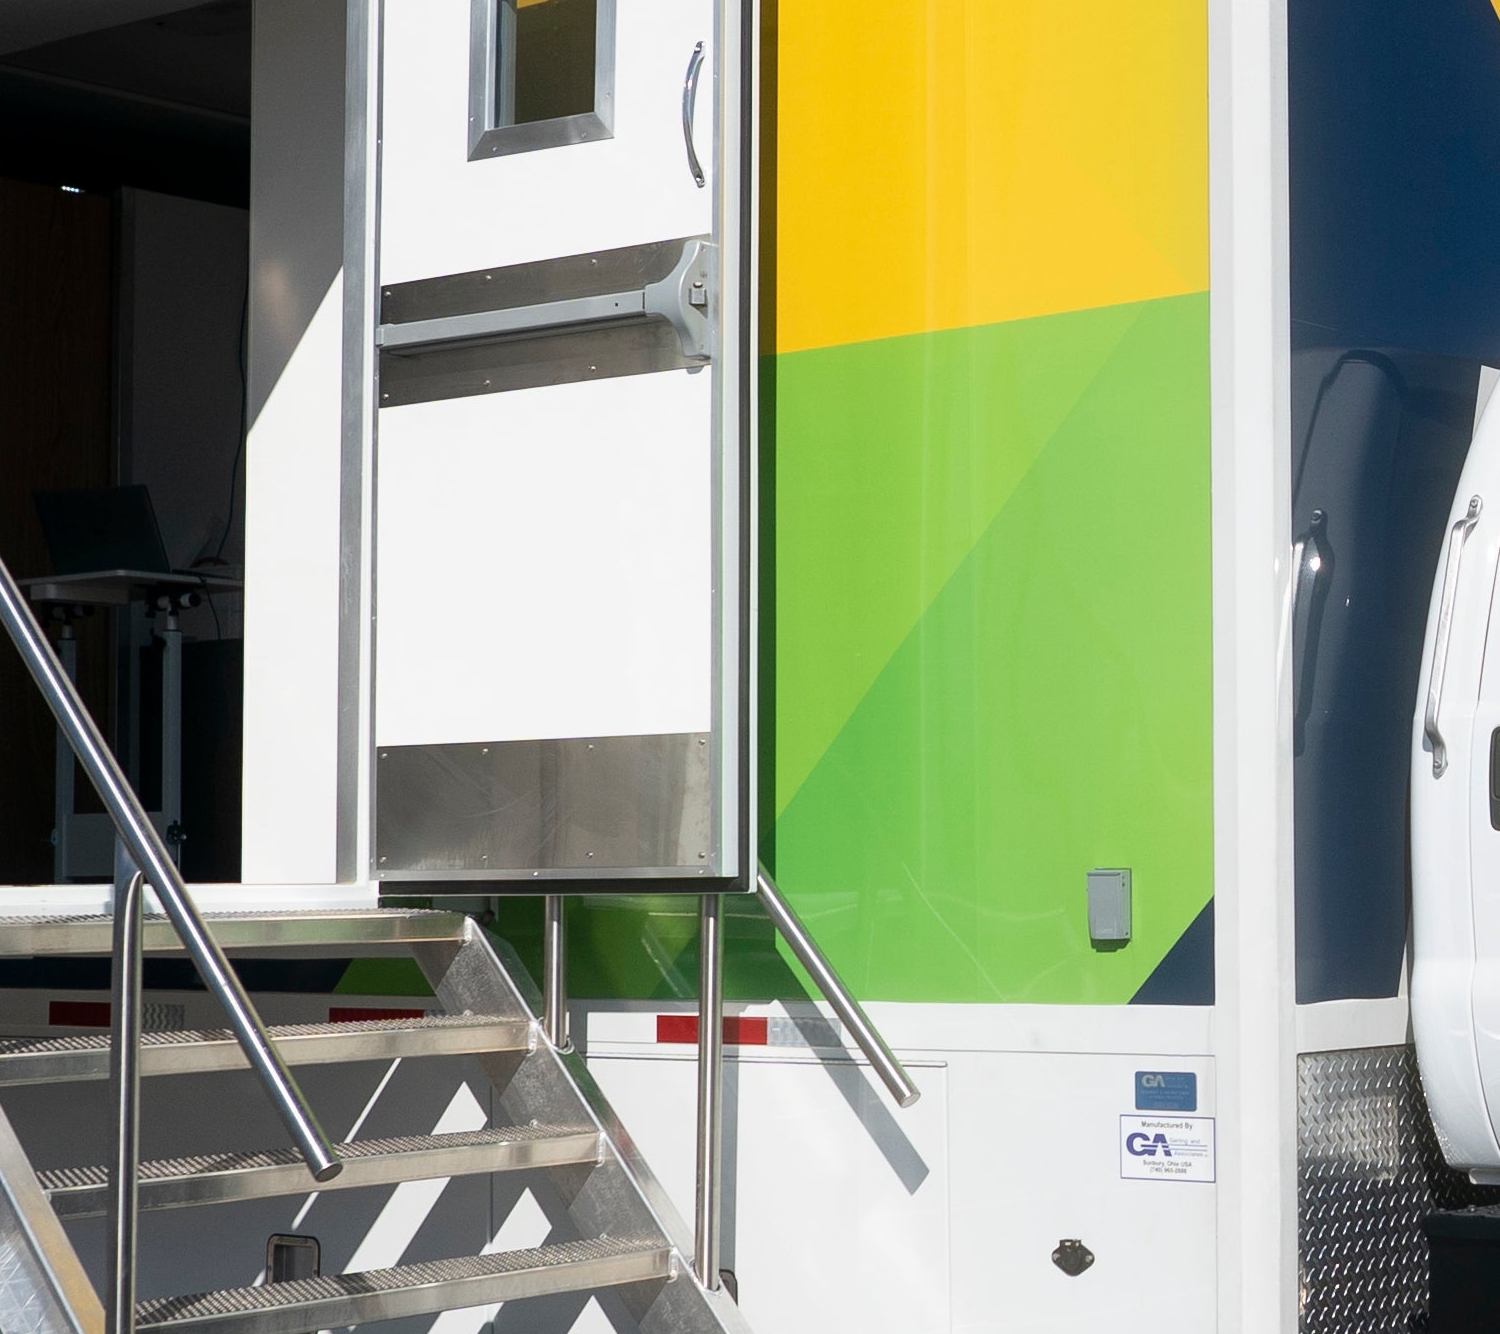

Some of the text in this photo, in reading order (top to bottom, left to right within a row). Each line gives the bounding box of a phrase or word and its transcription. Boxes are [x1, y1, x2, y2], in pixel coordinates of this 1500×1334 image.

[1141, 1121, 1193, 1130] Manufactured By
[1126, 1132, 1173, 1157] GA
